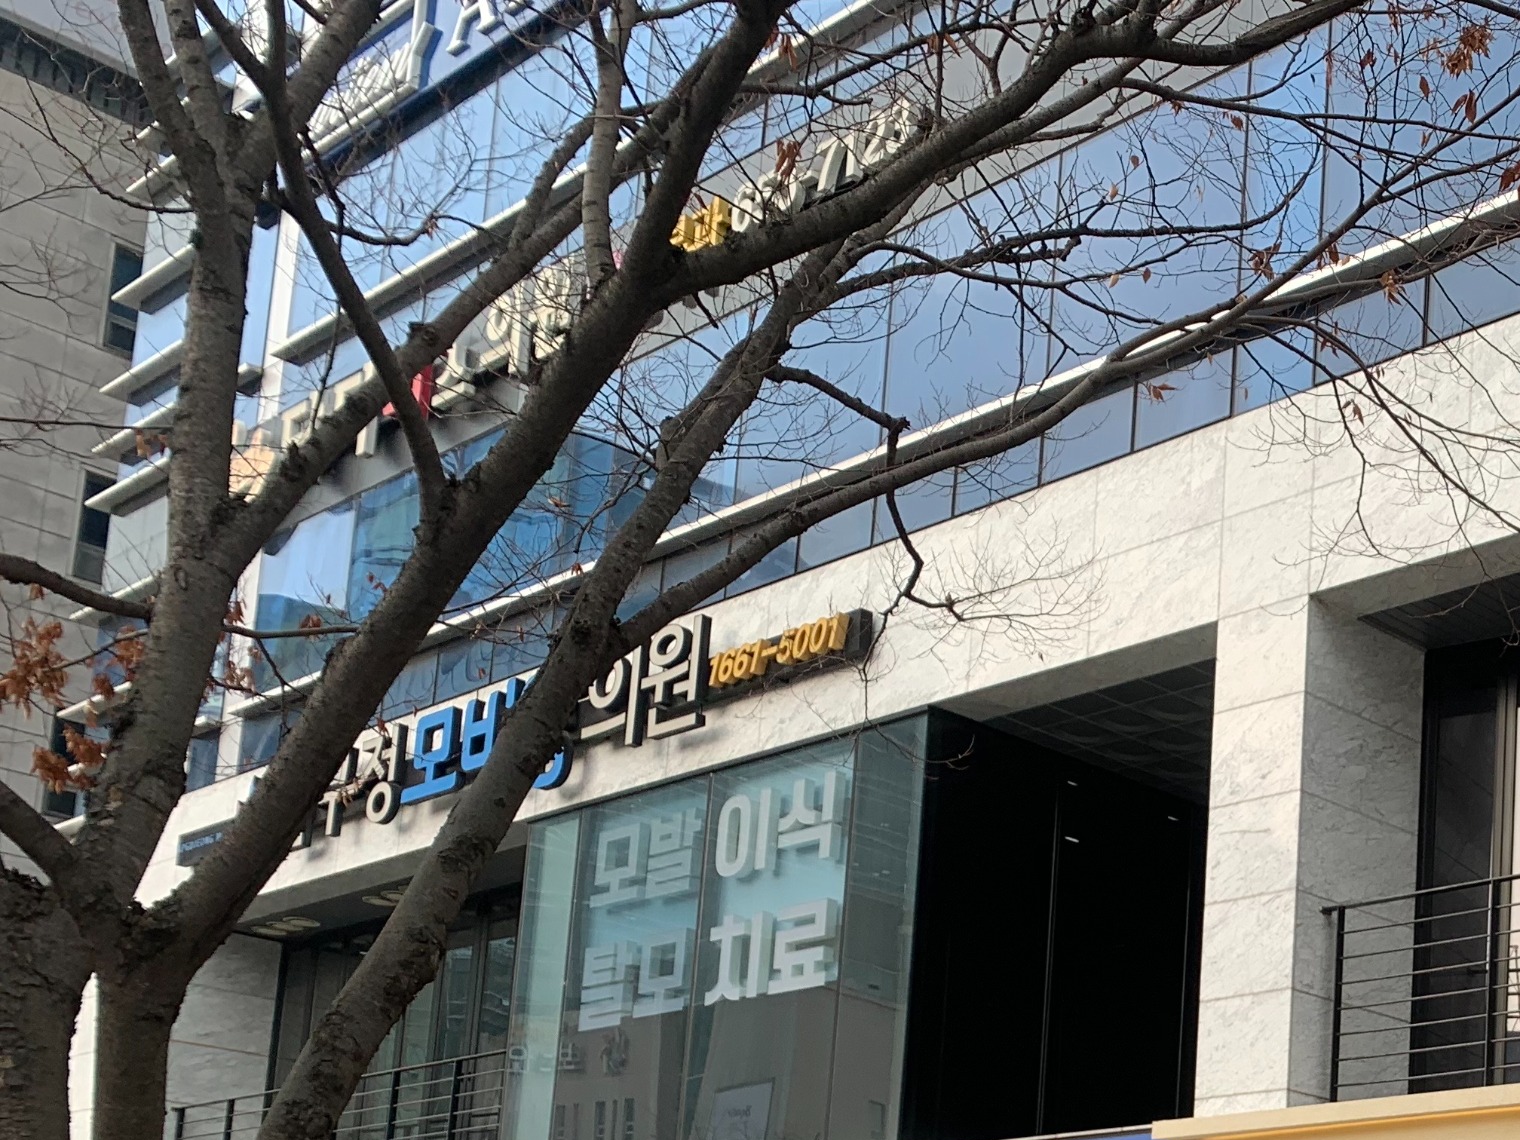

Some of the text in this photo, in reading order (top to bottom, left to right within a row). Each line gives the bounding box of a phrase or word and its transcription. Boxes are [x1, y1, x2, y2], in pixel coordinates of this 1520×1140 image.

[709, 612, 850, 688] 1661-5001
[589, 769, 846, 908] 모발 이식
[578, 898, 840, 1032] 탈모 치료
